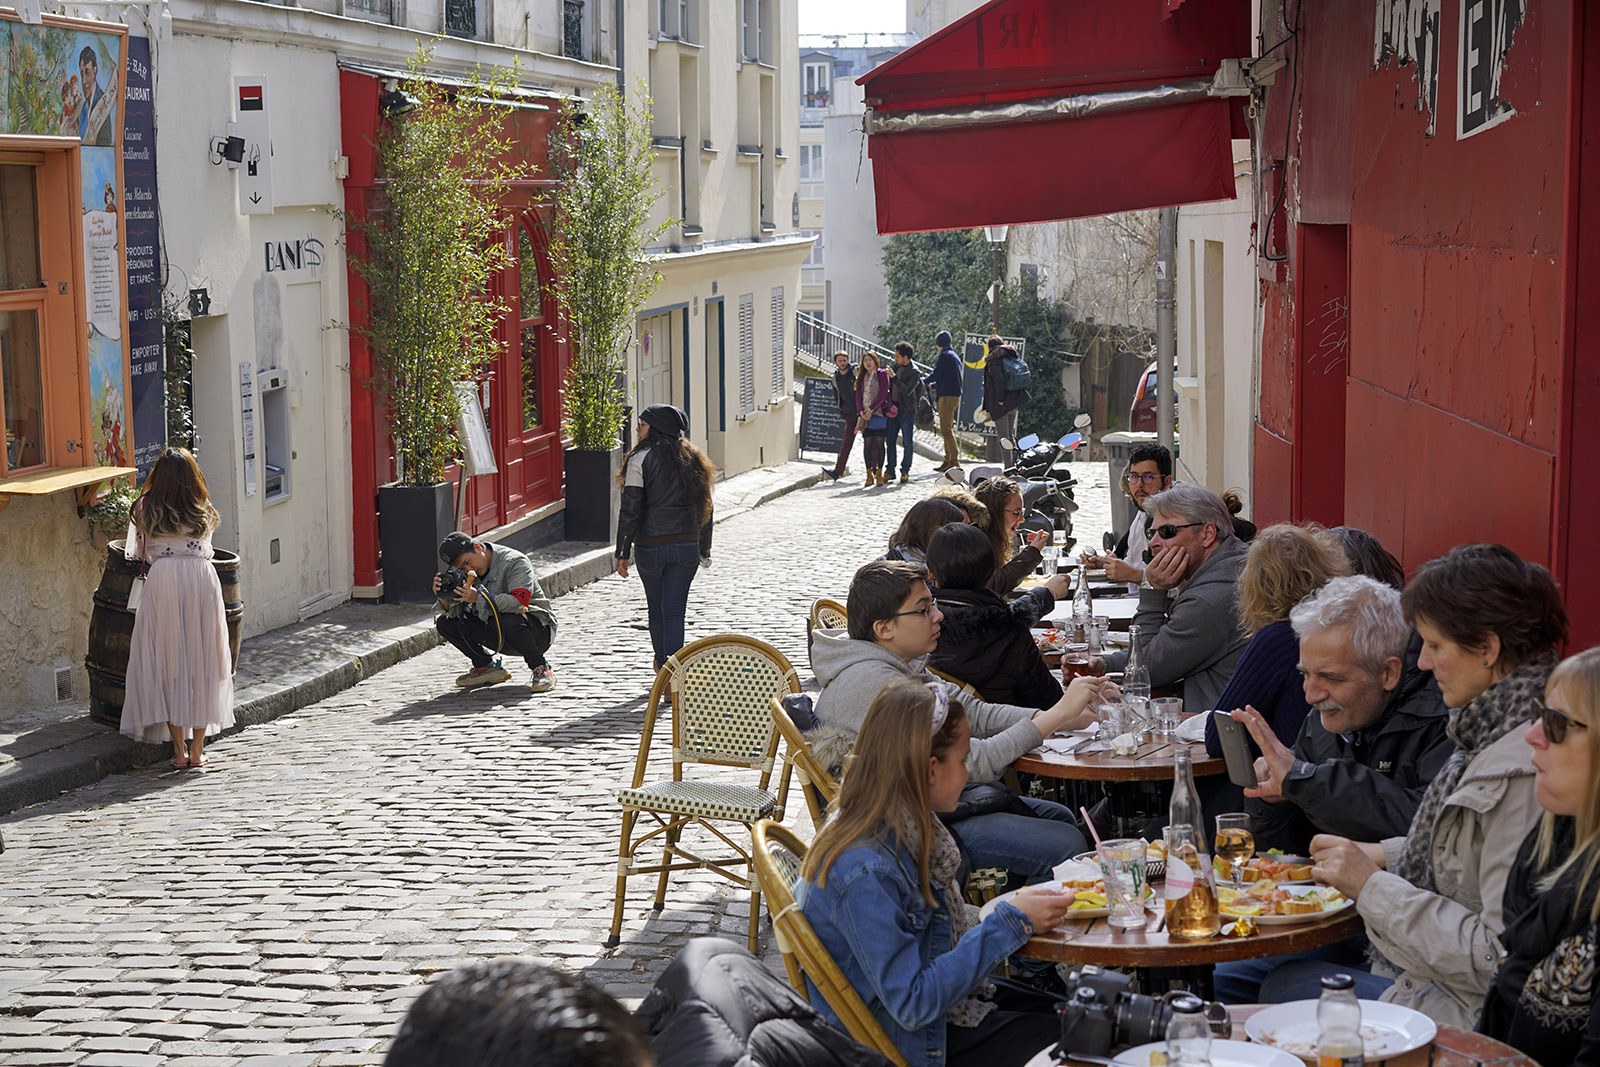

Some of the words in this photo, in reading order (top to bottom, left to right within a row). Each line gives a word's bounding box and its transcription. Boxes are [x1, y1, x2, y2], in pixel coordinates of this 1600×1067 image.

[126, 246, 154, 256] PRODUITS
[131, 344, 160, 359] EMPORTER
[144, 361, 158, 374] AWAY
